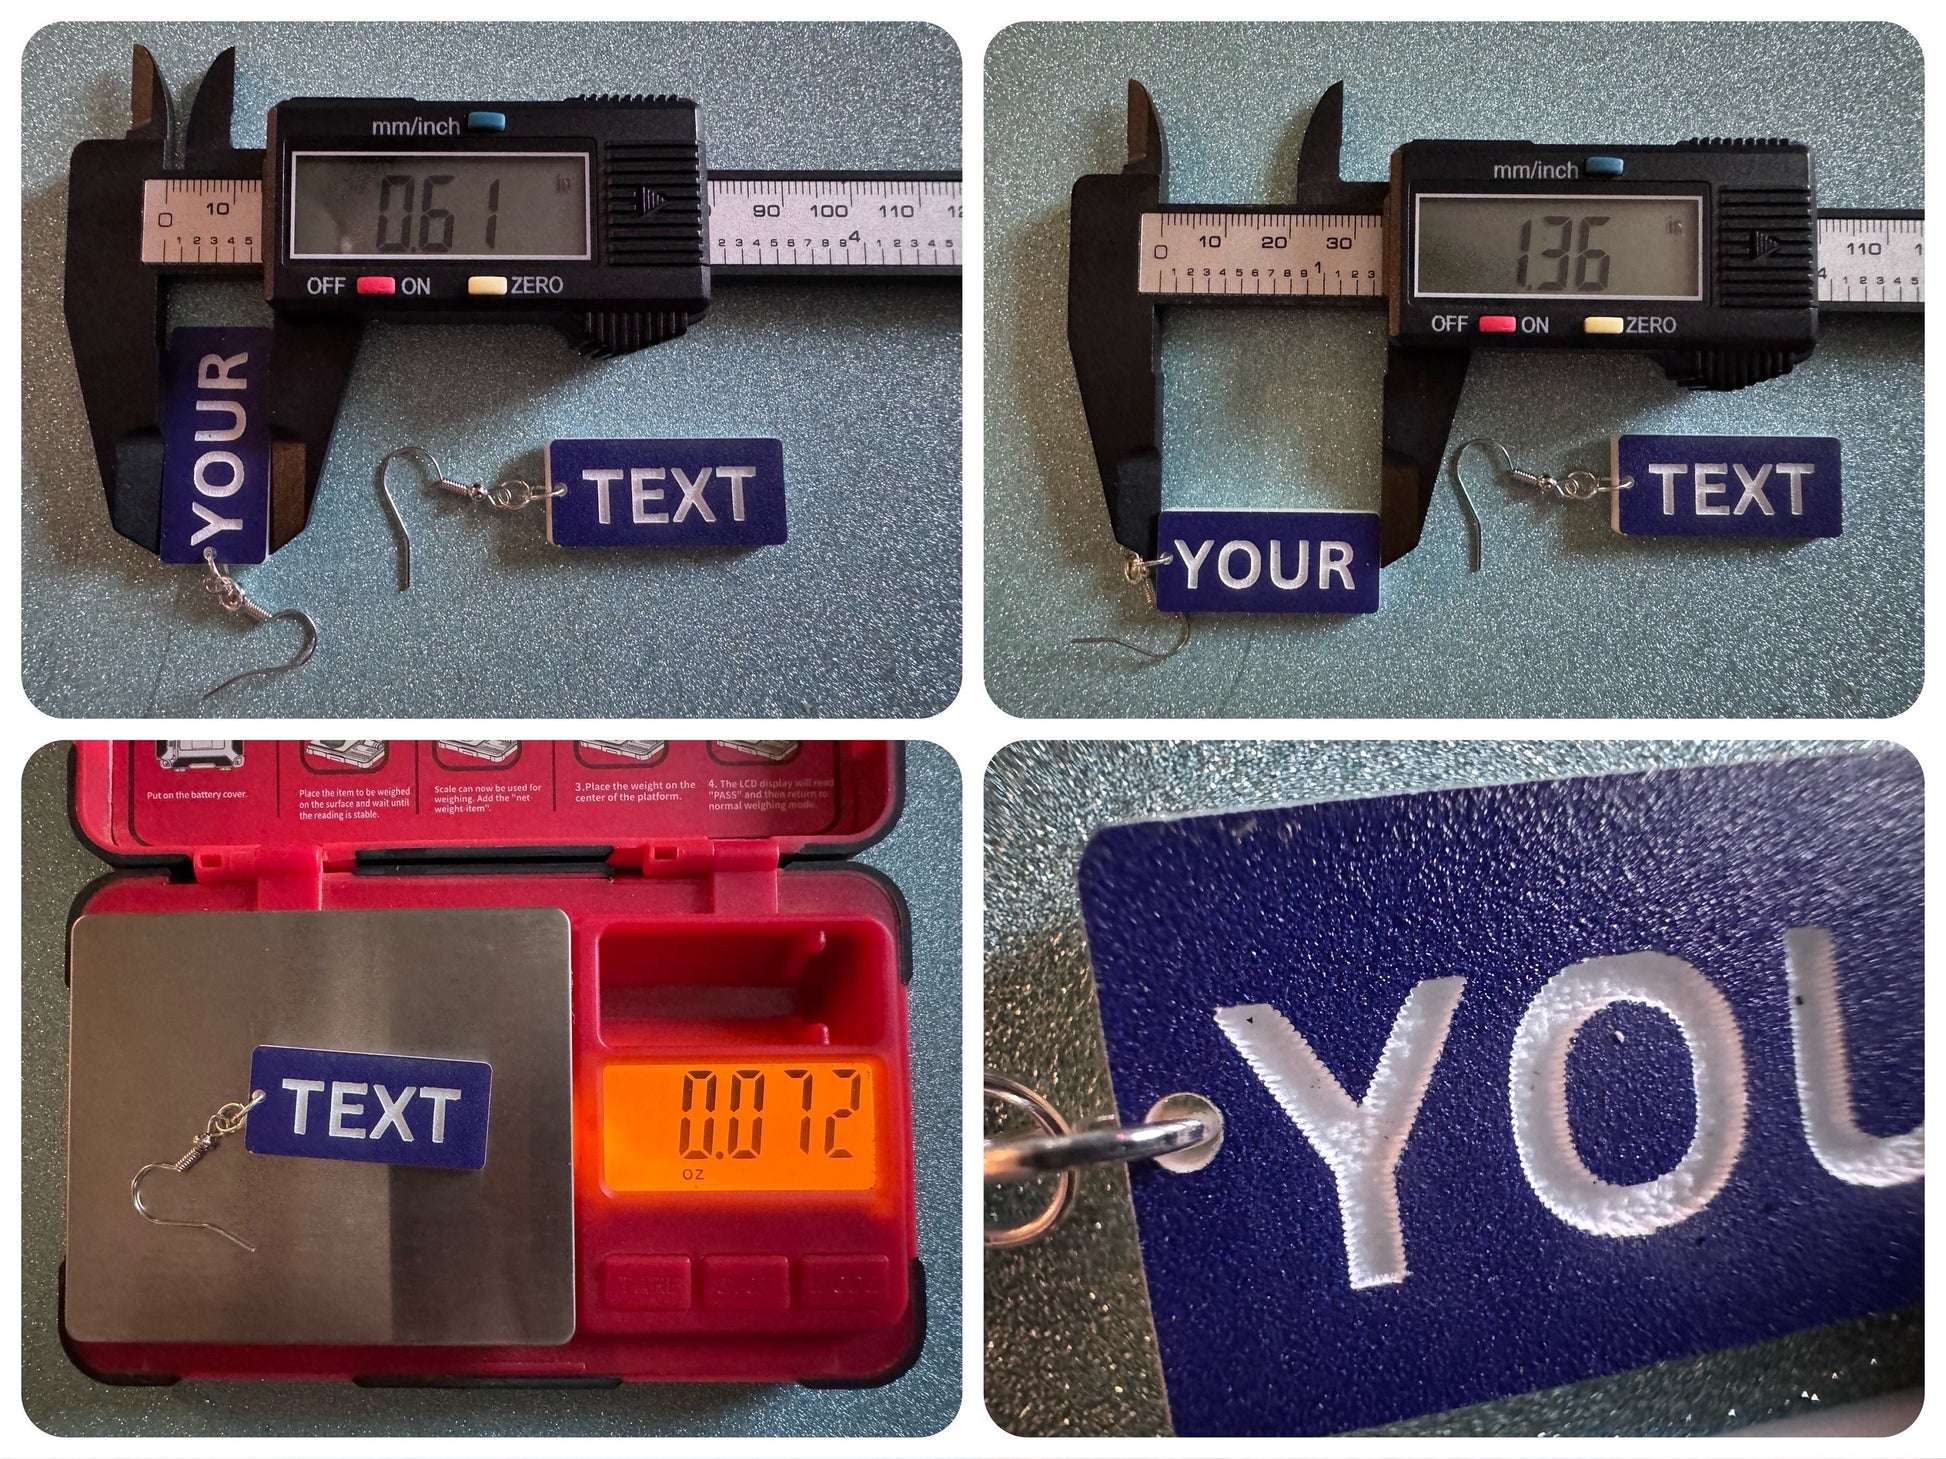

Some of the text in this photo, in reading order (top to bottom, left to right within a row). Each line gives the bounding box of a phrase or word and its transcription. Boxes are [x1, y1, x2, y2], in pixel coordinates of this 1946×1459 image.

[372, 117, 461, 136] mm/inch
[1493, 161, 1579, 180] mm/inch
[158, 202, 230, 228] 0 10
[376, 175, 500, 253] 0.61
[753, 204, 781, 218] 90
[810, 204, 848, 218] 100
[879, 205, 914, 218] 110
[176, 236, 253, 245] 1 2 3 4 5
[718, 230, 954, 247] 2 3 4 5 6 7 8 9 4 1 2 3 4 5
[1154, 235, 1352, 259] 0 10 20 30
[1516, 216, 1610, 291] 1.36
[1847, 242, 1882, 255] 110
[1187, 268, 1195, 276] 2
[1203, 268, 1211, 276] 3
[1219, 268, 1227, 276] 4
[1235, 269, 1243, 277] 5
[1251, 269, 1259, 277] 6
[1268, 269, 1275, 277] 7
[1283, 269, 1292, 277] 8
[1300, 269, 1308, 277] 9
[1314, 261, 1322, 274] 1
[1335, 270, 1340, 278] 1
[1351, 270, 1359, 278] 2
[1368, 270, 1375, 278] 3
[307, 276, 564, 295] OFF ON ZERO
[1843, 276, 1848, 284] 1
[1860, 276, 1867, 285] 2
[1876, 276, 1885, 285] 3
[1893, 277, 1902, 285] 4
[1911, 276, 1919, 285] 5
[1431, 315, 1677, 334] OFF ON ZERO
[190, 351, 249, 546] YOUR
[582, 465, 757, 525] TEXT
[1648, 463, 1815, 516] TEXT
[1174, 538, 1356, 590] YOUR
[434, 785, 457, 793] Scale
[495, 784, 506, 792] be
[507, 784, 528, 792] used
[612, 782, 629, 791] the
[631, 781, 663, 792] weight
[665, 782, 678, 790] on
[680, 780, 696, 789] the
[708, 779, 718, 788] 4.
[720, 779, 737, 789] The
[740, 779, 758, 788] LCD
[760, 778, 793, 789] display
[795, 778, 812, 787] will
[147, 791, 161, 800] Put
[175, 791, 190, 799] the
[191, 791, 221, 800] battery
[299, 787, 411, 798] Place the item to be weighed
[434, 795, 475, 805] weighing.
[477, 794, 493, 802] Add
[495, 794, 510, 802] the
[575, 792, 682, 803] center of the platform.
[708, 790, 829, 800] "PASS" and then return to
[299, 798, 410, 809] on the surface and wait until
[708, 801, 742, 811] normal
[743, 800, 787, 812] weighing
[299, 810, 380, 821] the reading is stable.
[282, 1078, 462, 1144] TEXT
[679, 1069, 861, 1160] 0.072
